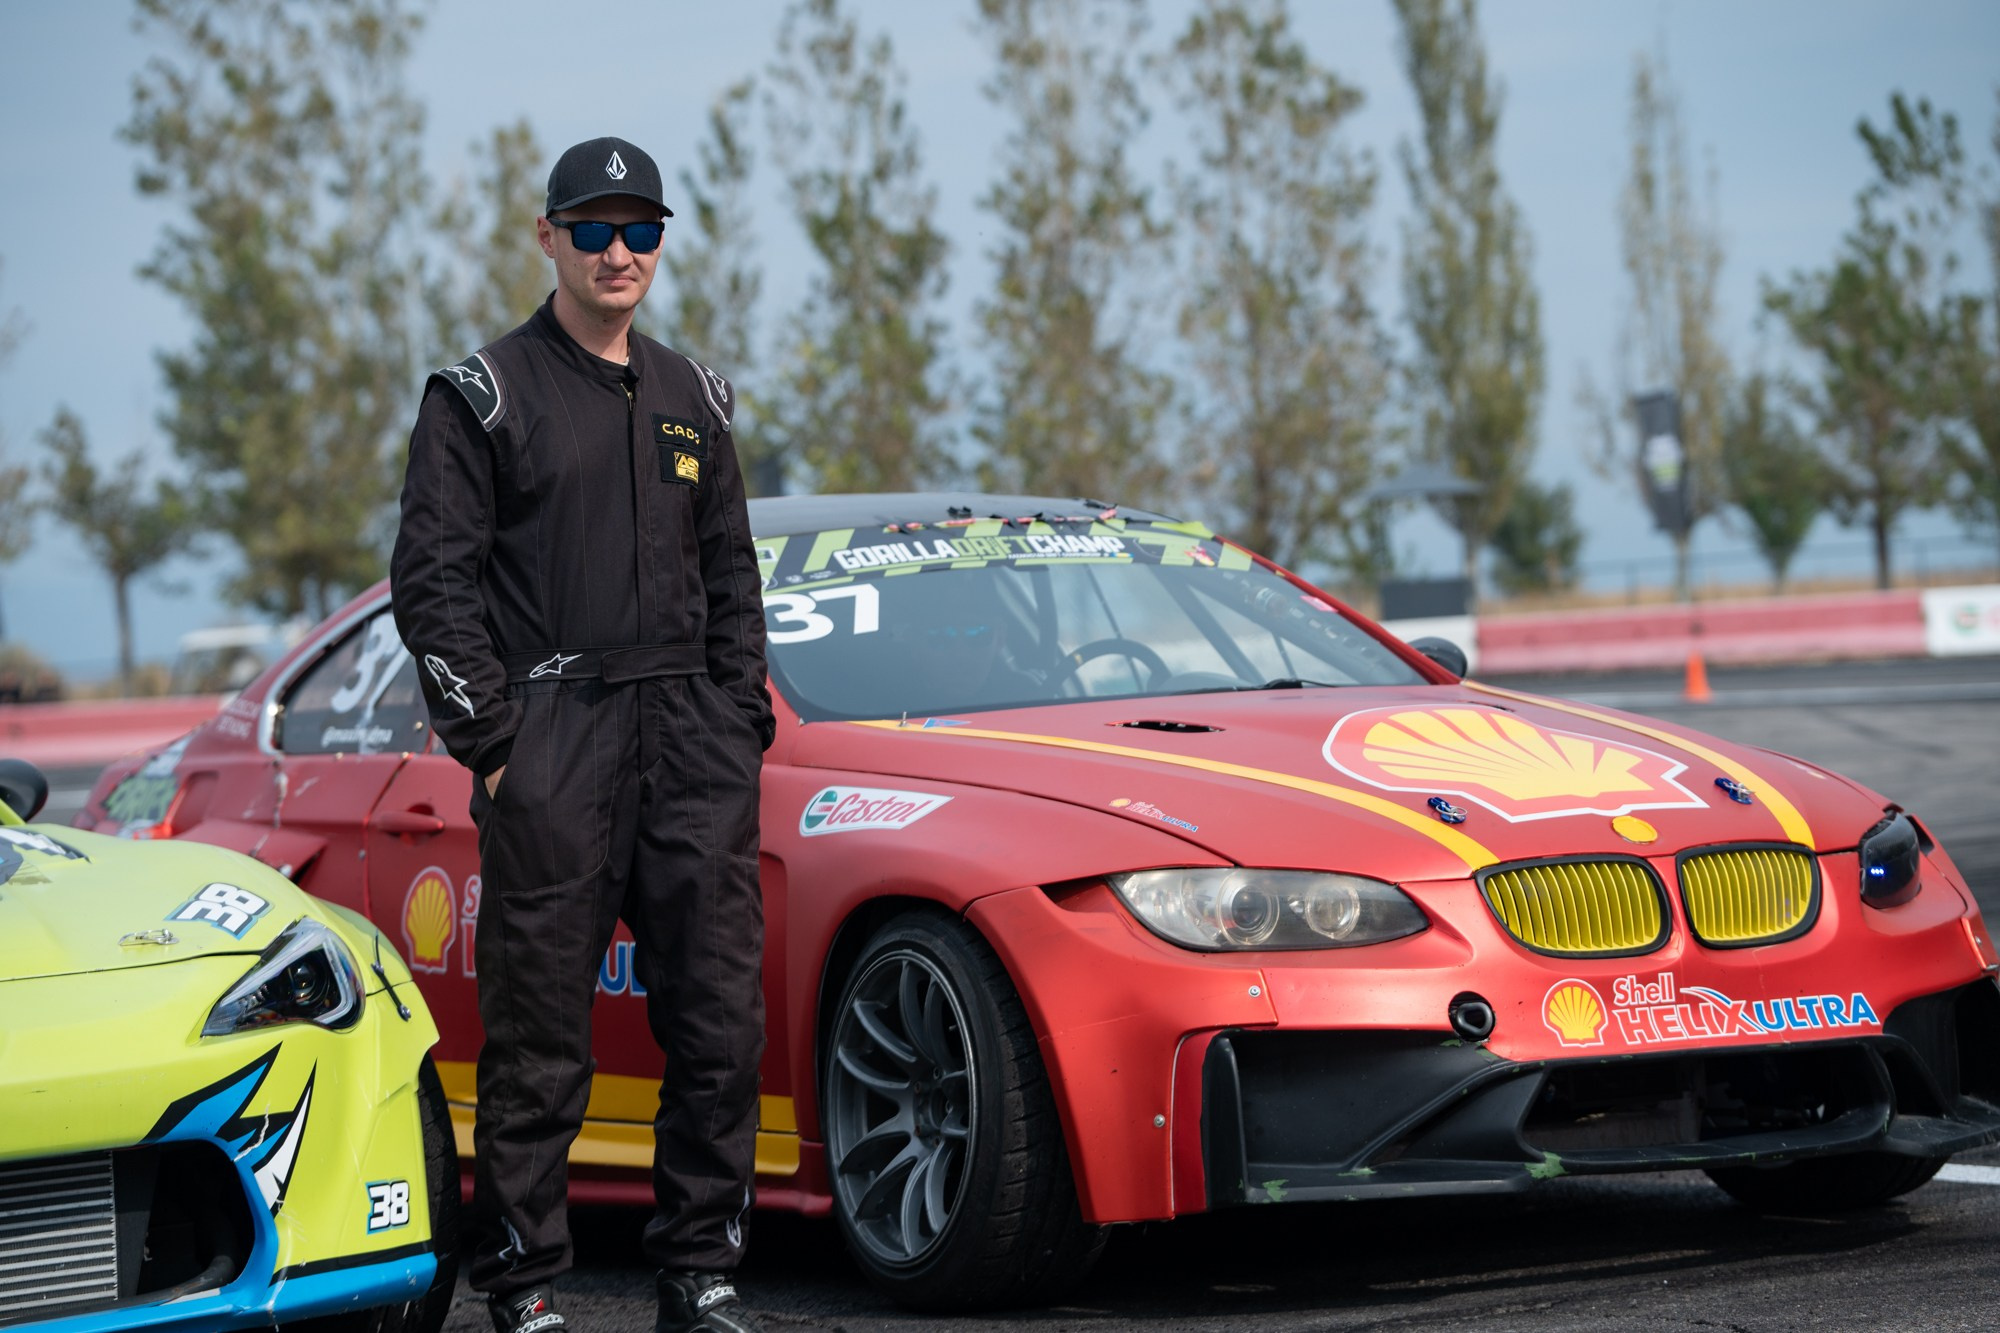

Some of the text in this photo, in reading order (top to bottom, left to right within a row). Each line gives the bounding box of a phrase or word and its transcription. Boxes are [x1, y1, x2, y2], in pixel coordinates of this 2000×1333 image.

[763, 584, 879, 644] 37
[826, 793, 934, 825] Castrol
[173, 882, 269, 935] 38
[1613, 972, 1674, 1005] Shell
[1612, 989, 1880, 1044] HELIX ULTRA
[367, 1180, 410, 1231] 38
